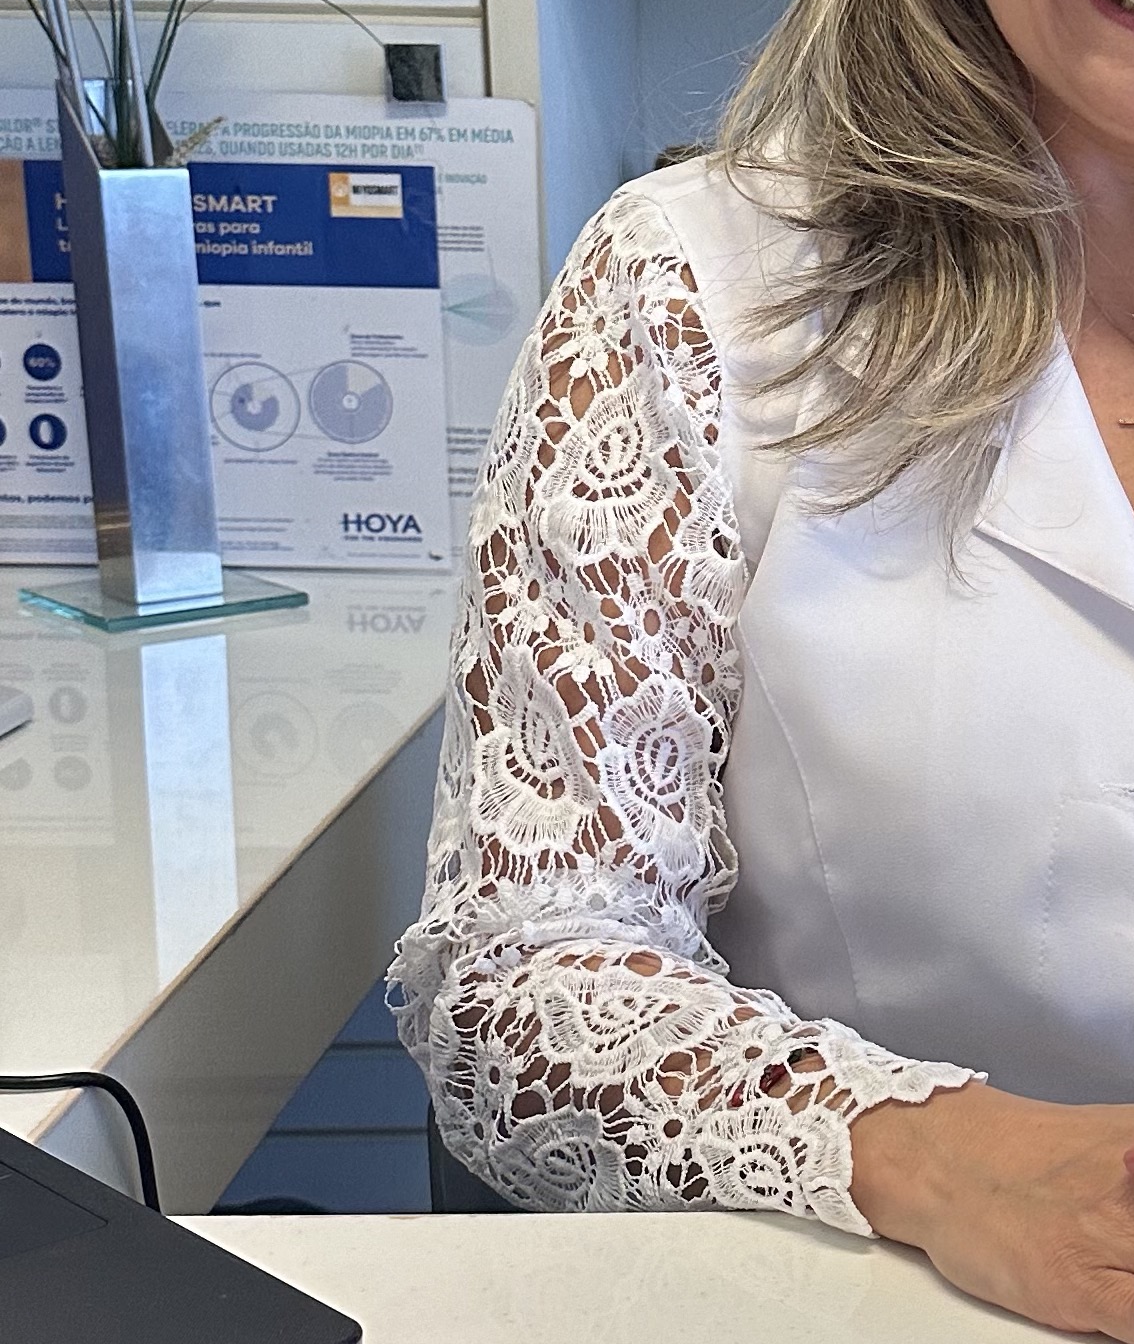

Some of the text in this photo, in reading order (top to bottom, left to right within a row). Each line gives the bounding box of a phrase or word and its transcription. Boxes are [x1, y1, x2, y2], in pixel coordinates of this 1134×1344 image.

[233, 121, 321, 139] PROGRESSÃO
[325, 124, 342, 139] DA
[346, 124, 393, 141] MIOPIA
[396, 126, 417, 142] EM
[419, 126, 446, 143] 67%
[449, 127, 468, 143] EM
[471, 125, 515, 144] MÉDIA
[219, 140, 275, 156] QUANDO
[278, 141, 332, 157] USADAS
[335, 143, 358, 157] 12H
[361, 144, 388, 158] POR
[193, 194, 277, 213] SMART
[219, 222, 260, 236] para
[251, 239, 314, 256] infantil
[342, 512, 422, 534] HOYA
